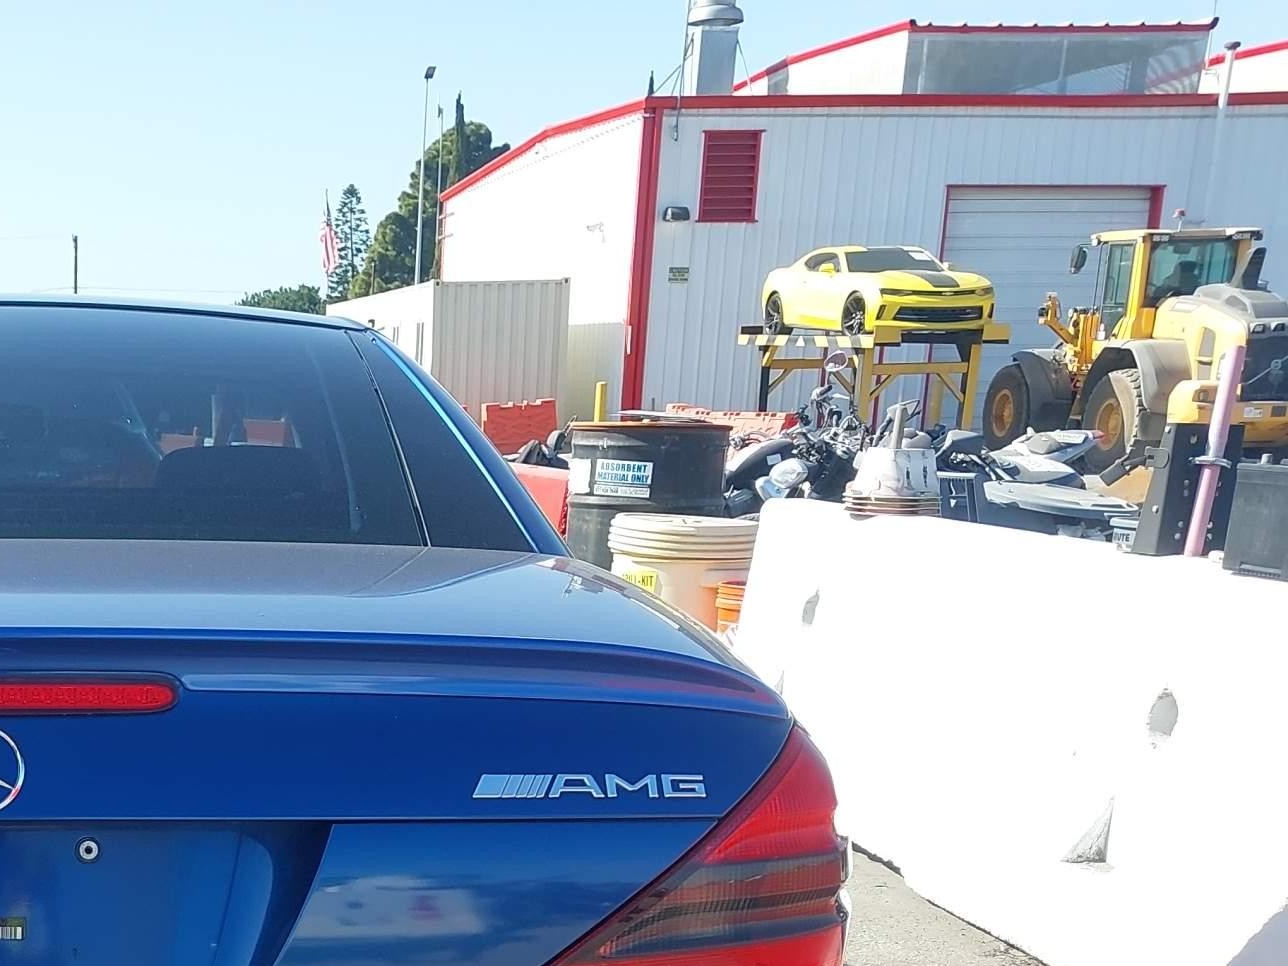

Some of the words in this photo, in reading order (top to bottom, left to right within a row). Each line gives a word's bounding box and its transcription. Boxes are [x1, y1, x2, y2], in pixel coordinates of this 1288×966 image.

[600, 461, 648, 473] ABSORBENT
[597, 471, 629, 481] MATERIAL
[631, 474, 650, 483] ONLY
[548, 773, 707, 798] AMG
